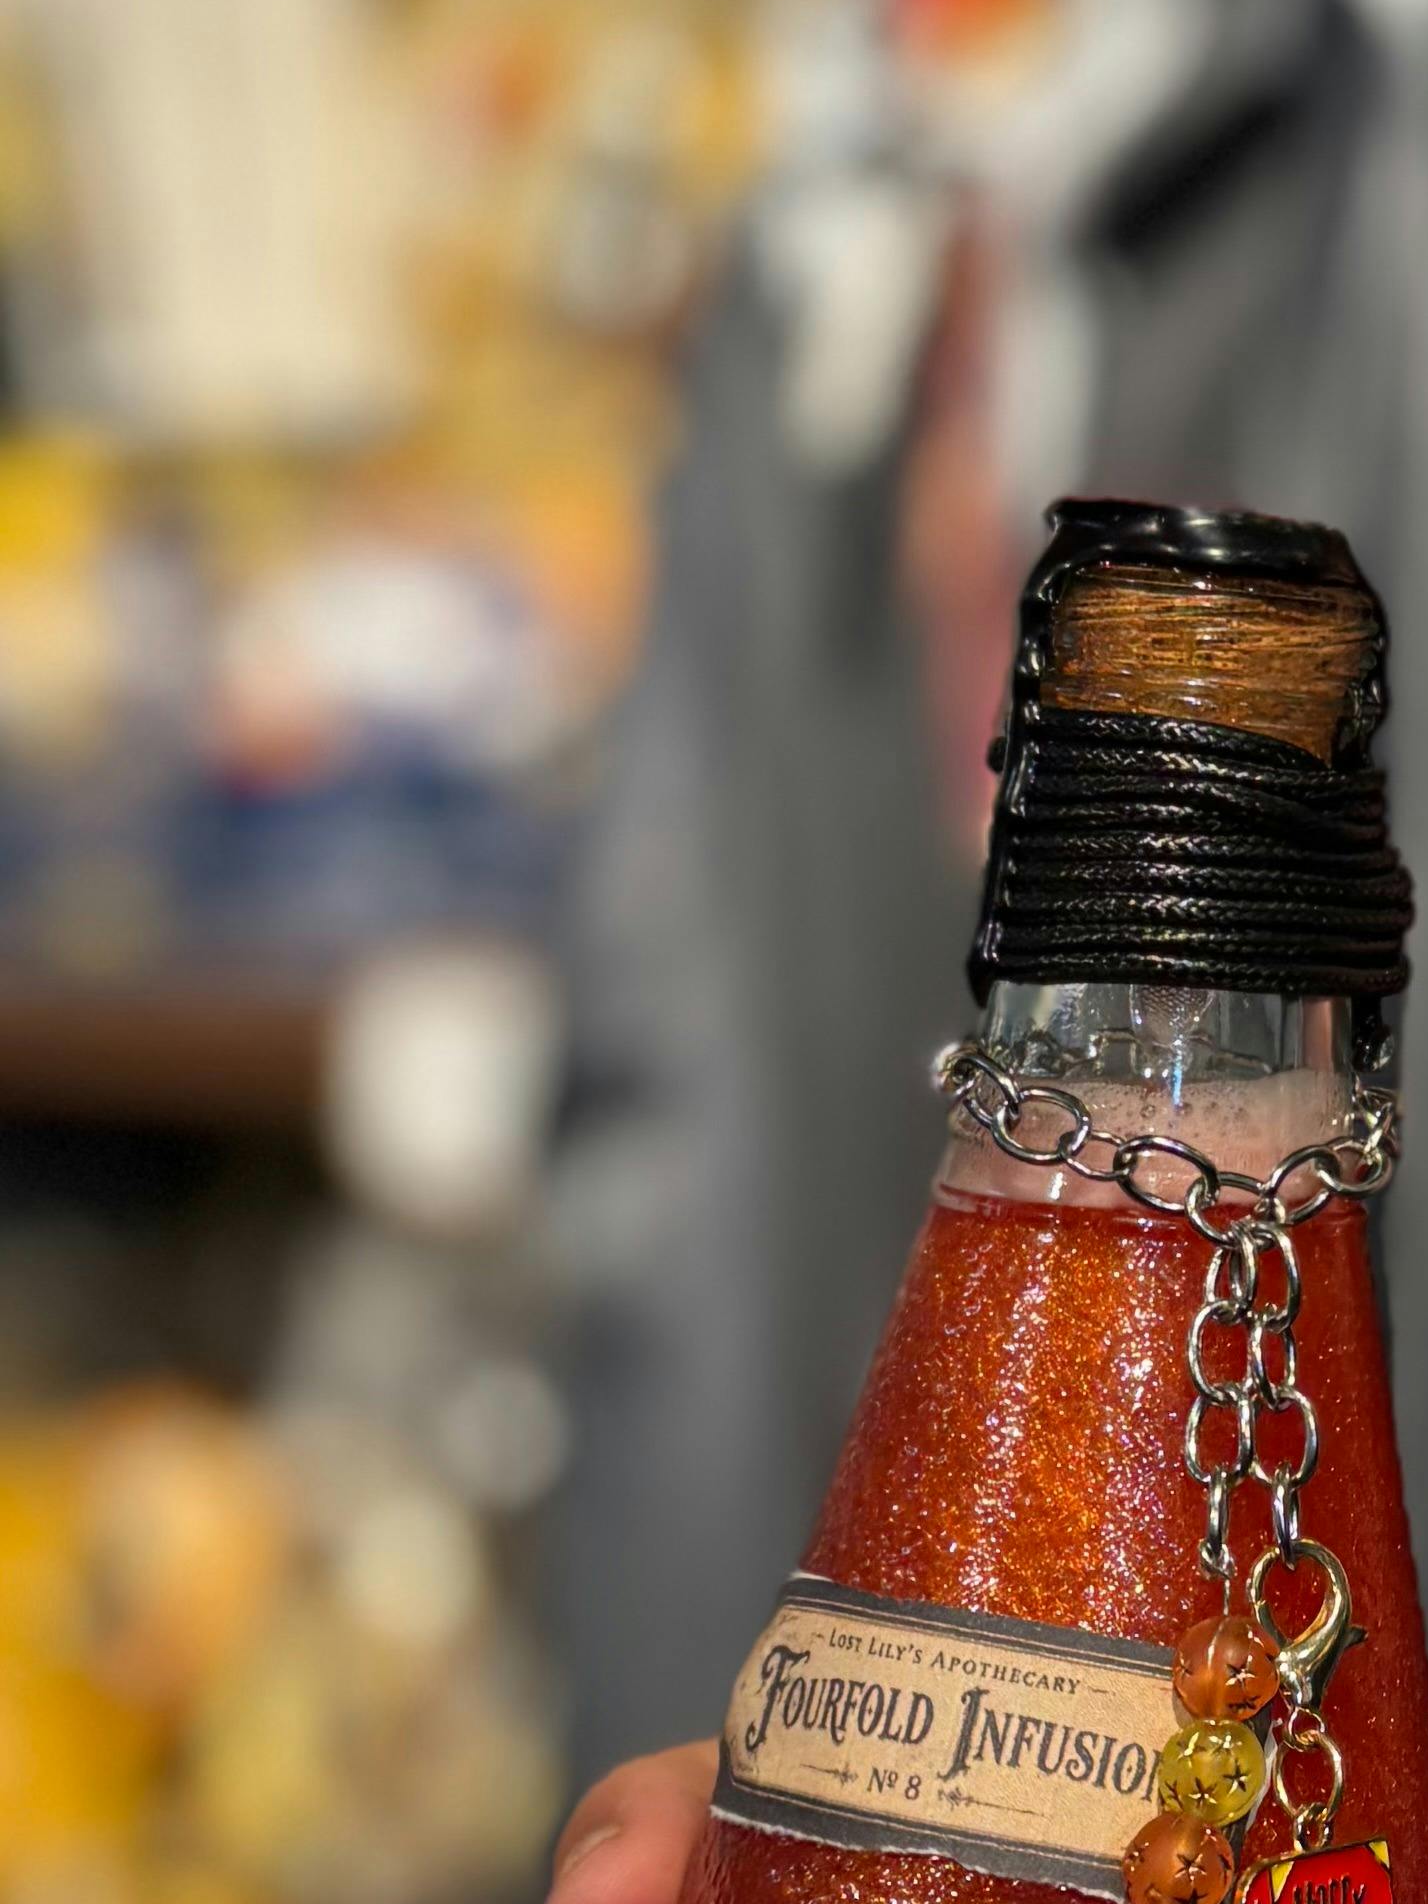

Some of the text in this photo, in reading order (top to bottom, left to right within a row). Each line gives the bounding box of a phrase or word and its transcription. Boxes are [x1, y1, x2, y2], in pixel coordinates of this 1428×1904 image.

[828, 1627, 1080, 1695] LOST LILY'S APOTHECARY
[745, 1645, 932, 1750] FOURFOLD
[904, 1776, 921, 1801] 8
